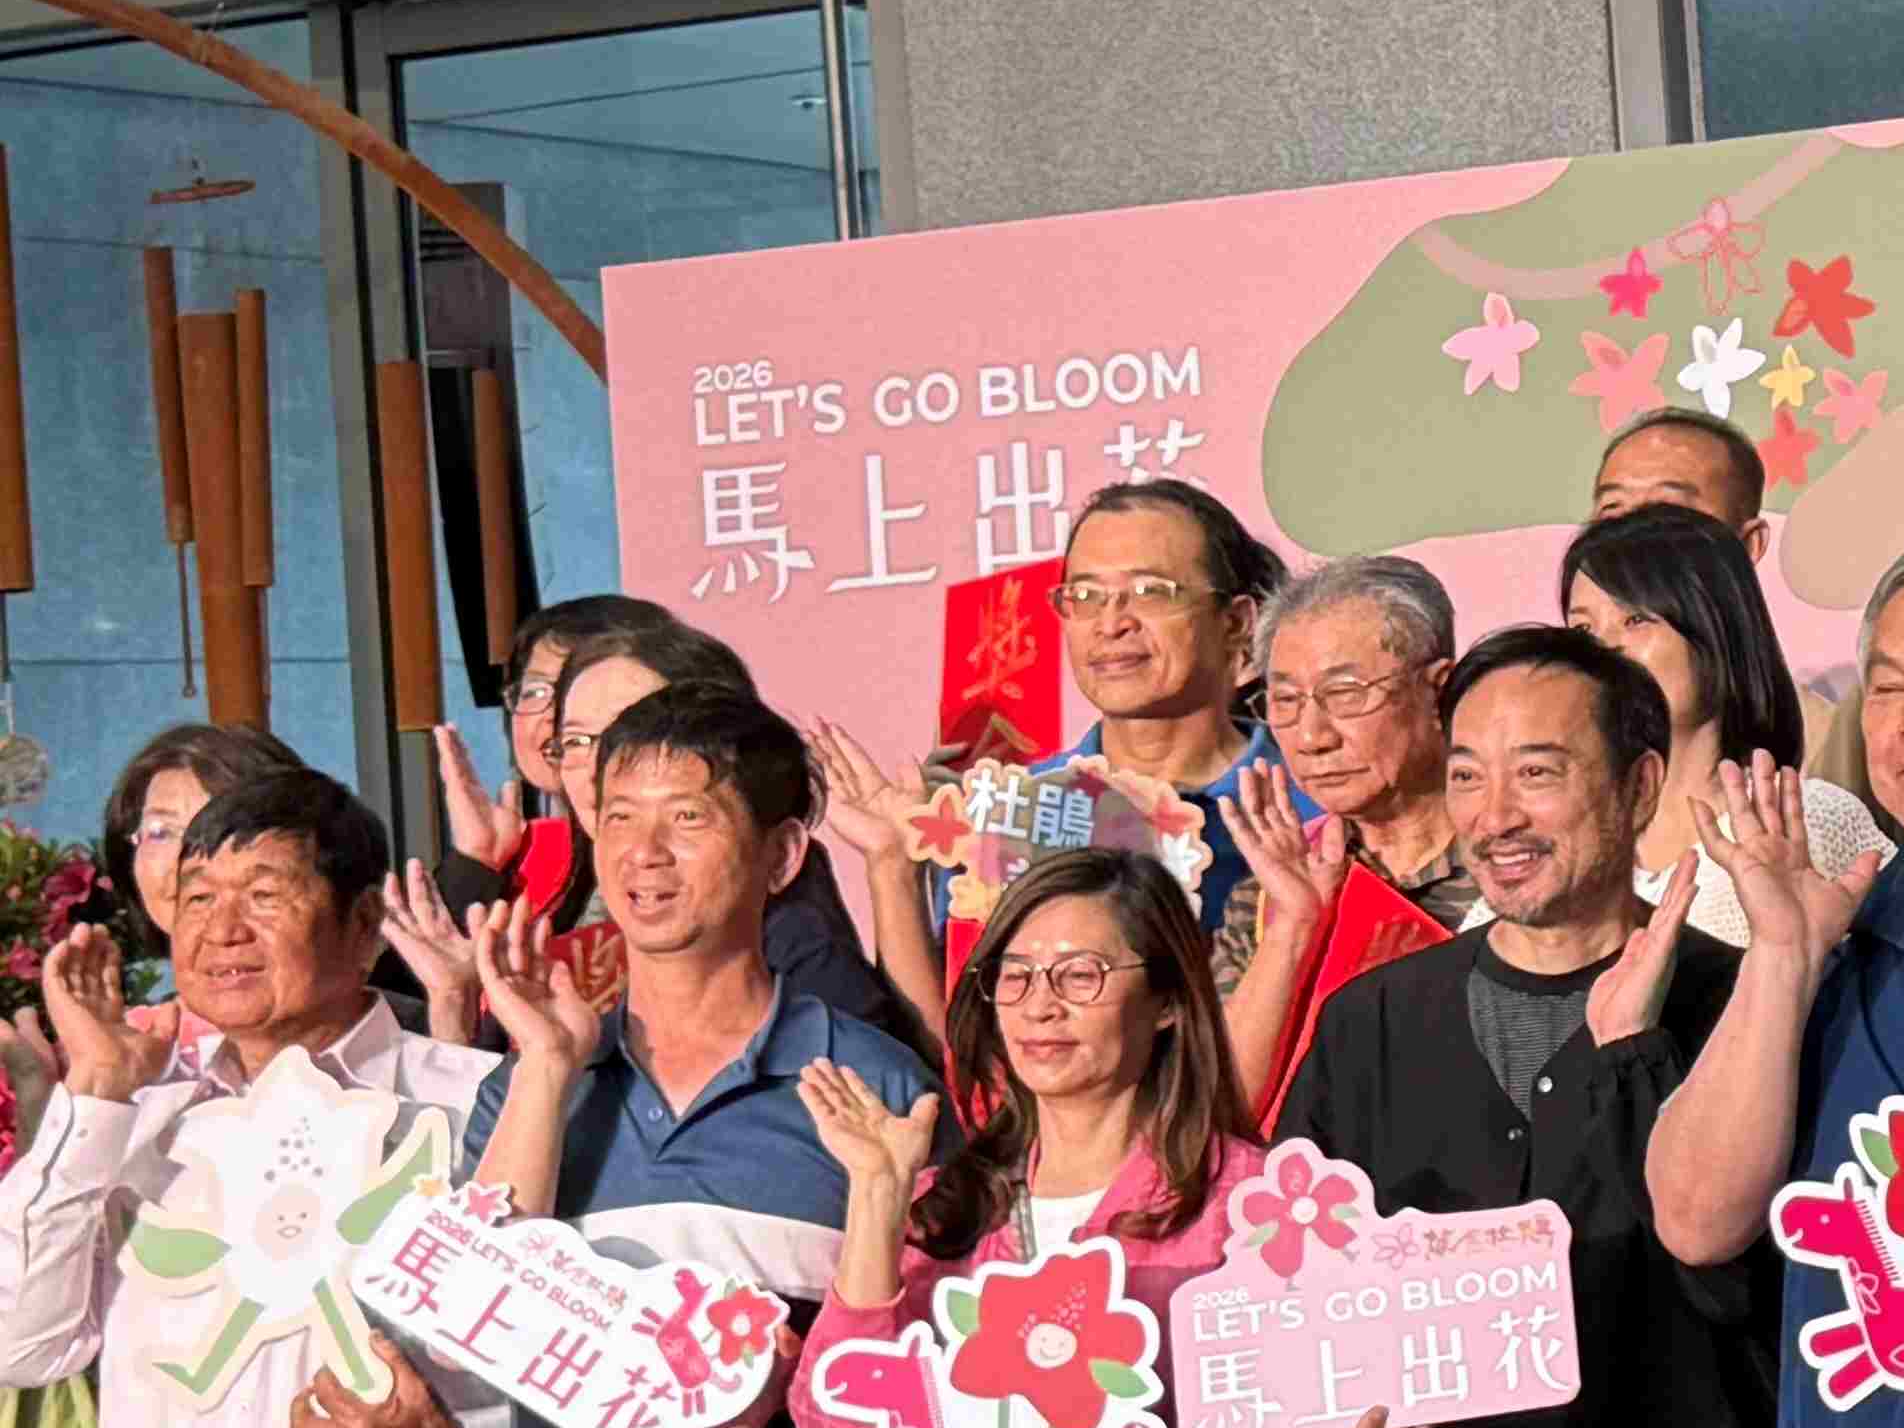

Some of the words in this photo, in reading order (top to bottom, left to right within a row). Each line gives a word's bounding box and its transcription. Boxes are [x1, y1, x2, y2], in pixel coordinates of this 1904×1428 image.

[693, 359, 773, 392] 2026
[693, 384, 845, 447] LET'S
[874, 374, 959, 428] GO
[979, 346, 1201, 418] BLOOM
[965, 772, 1096, 847] 杜鵑
[520, 1268, 548, 1292] GO
[547, 1285, 612, 1333] BLOOM
[1192, 1285, 1250, 1310] 2026
[1194, 1299, 1304, 1342] LET'S
[1325, 1287, 1388, 1322] GO
[1401, 1261, 1558, 1311] BLOOM
